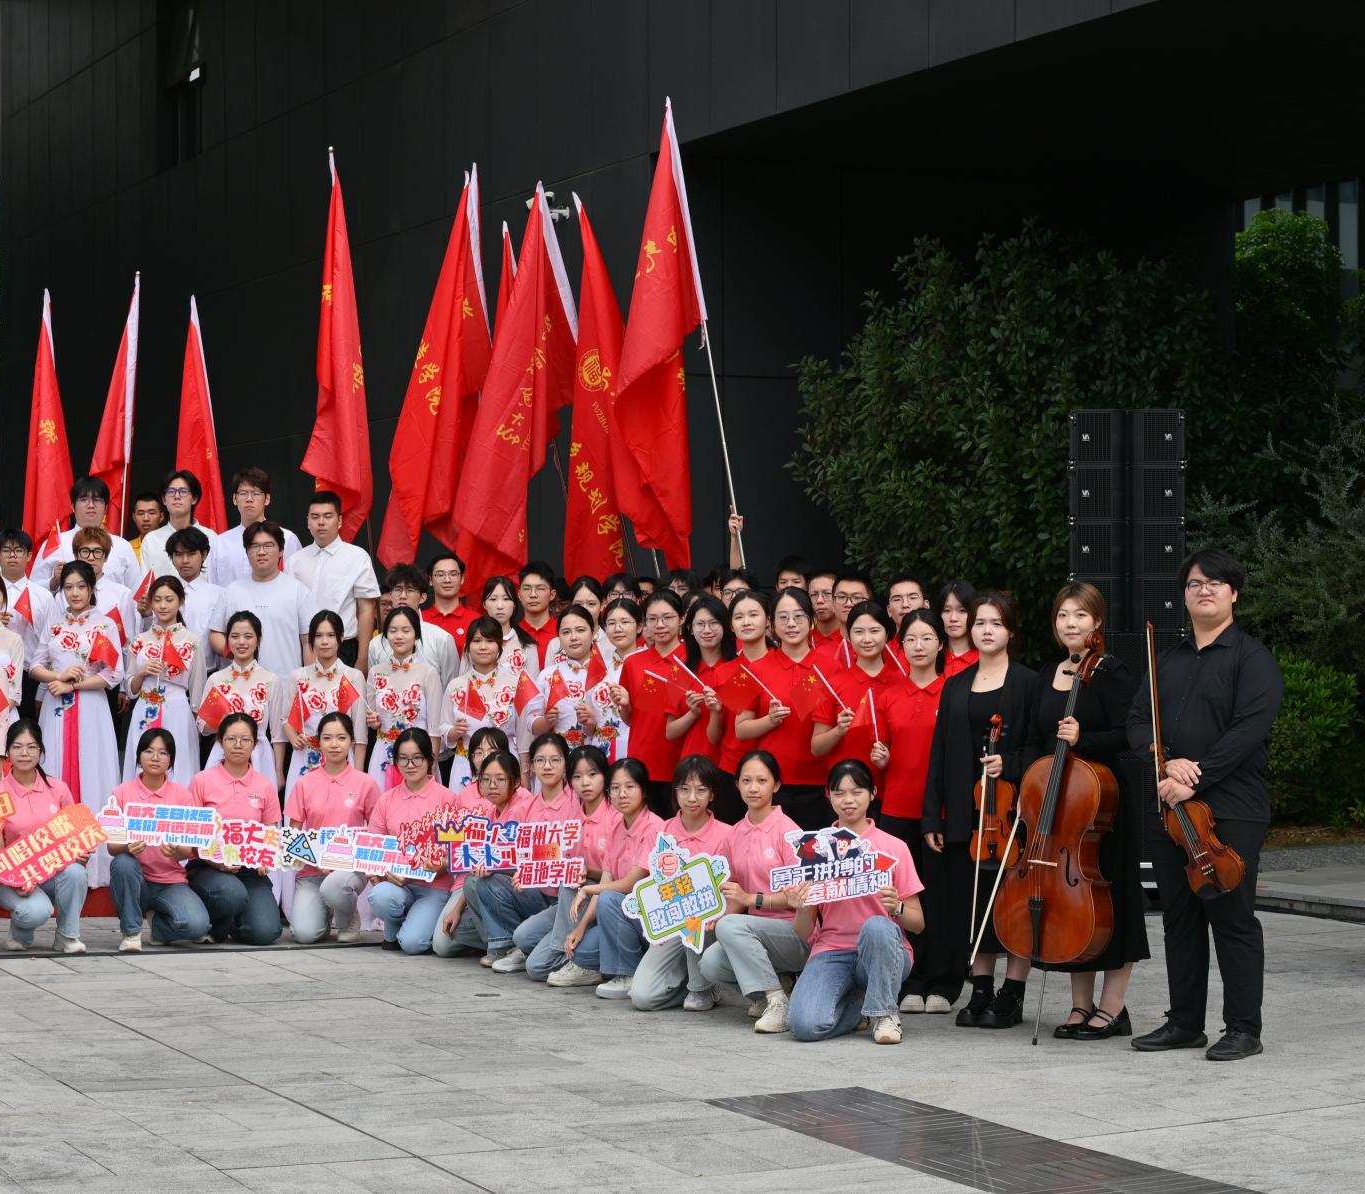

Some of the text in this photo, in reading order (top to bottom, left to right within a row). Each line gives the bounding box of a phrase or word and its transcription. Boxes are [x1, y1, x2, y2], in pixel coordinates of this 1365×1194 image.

[126, 805, 214, 823] 福大生日快乐
[129, 831, 210, 848] happy birthday
[517, 822, 579, 848] 福州大学
[18, 825, 108, 888] 共贺校庆
[356, 859, 387, 876] happy
[518, 860, 581, 886] 福地学府
[771, 853, 877, 891] 勇于拼搏的
[658, 875, 695, 902] 年轻
[806, 870, 891, 901] 奉献精神
[647, 885, 717, 932] 敢闯敢拼
